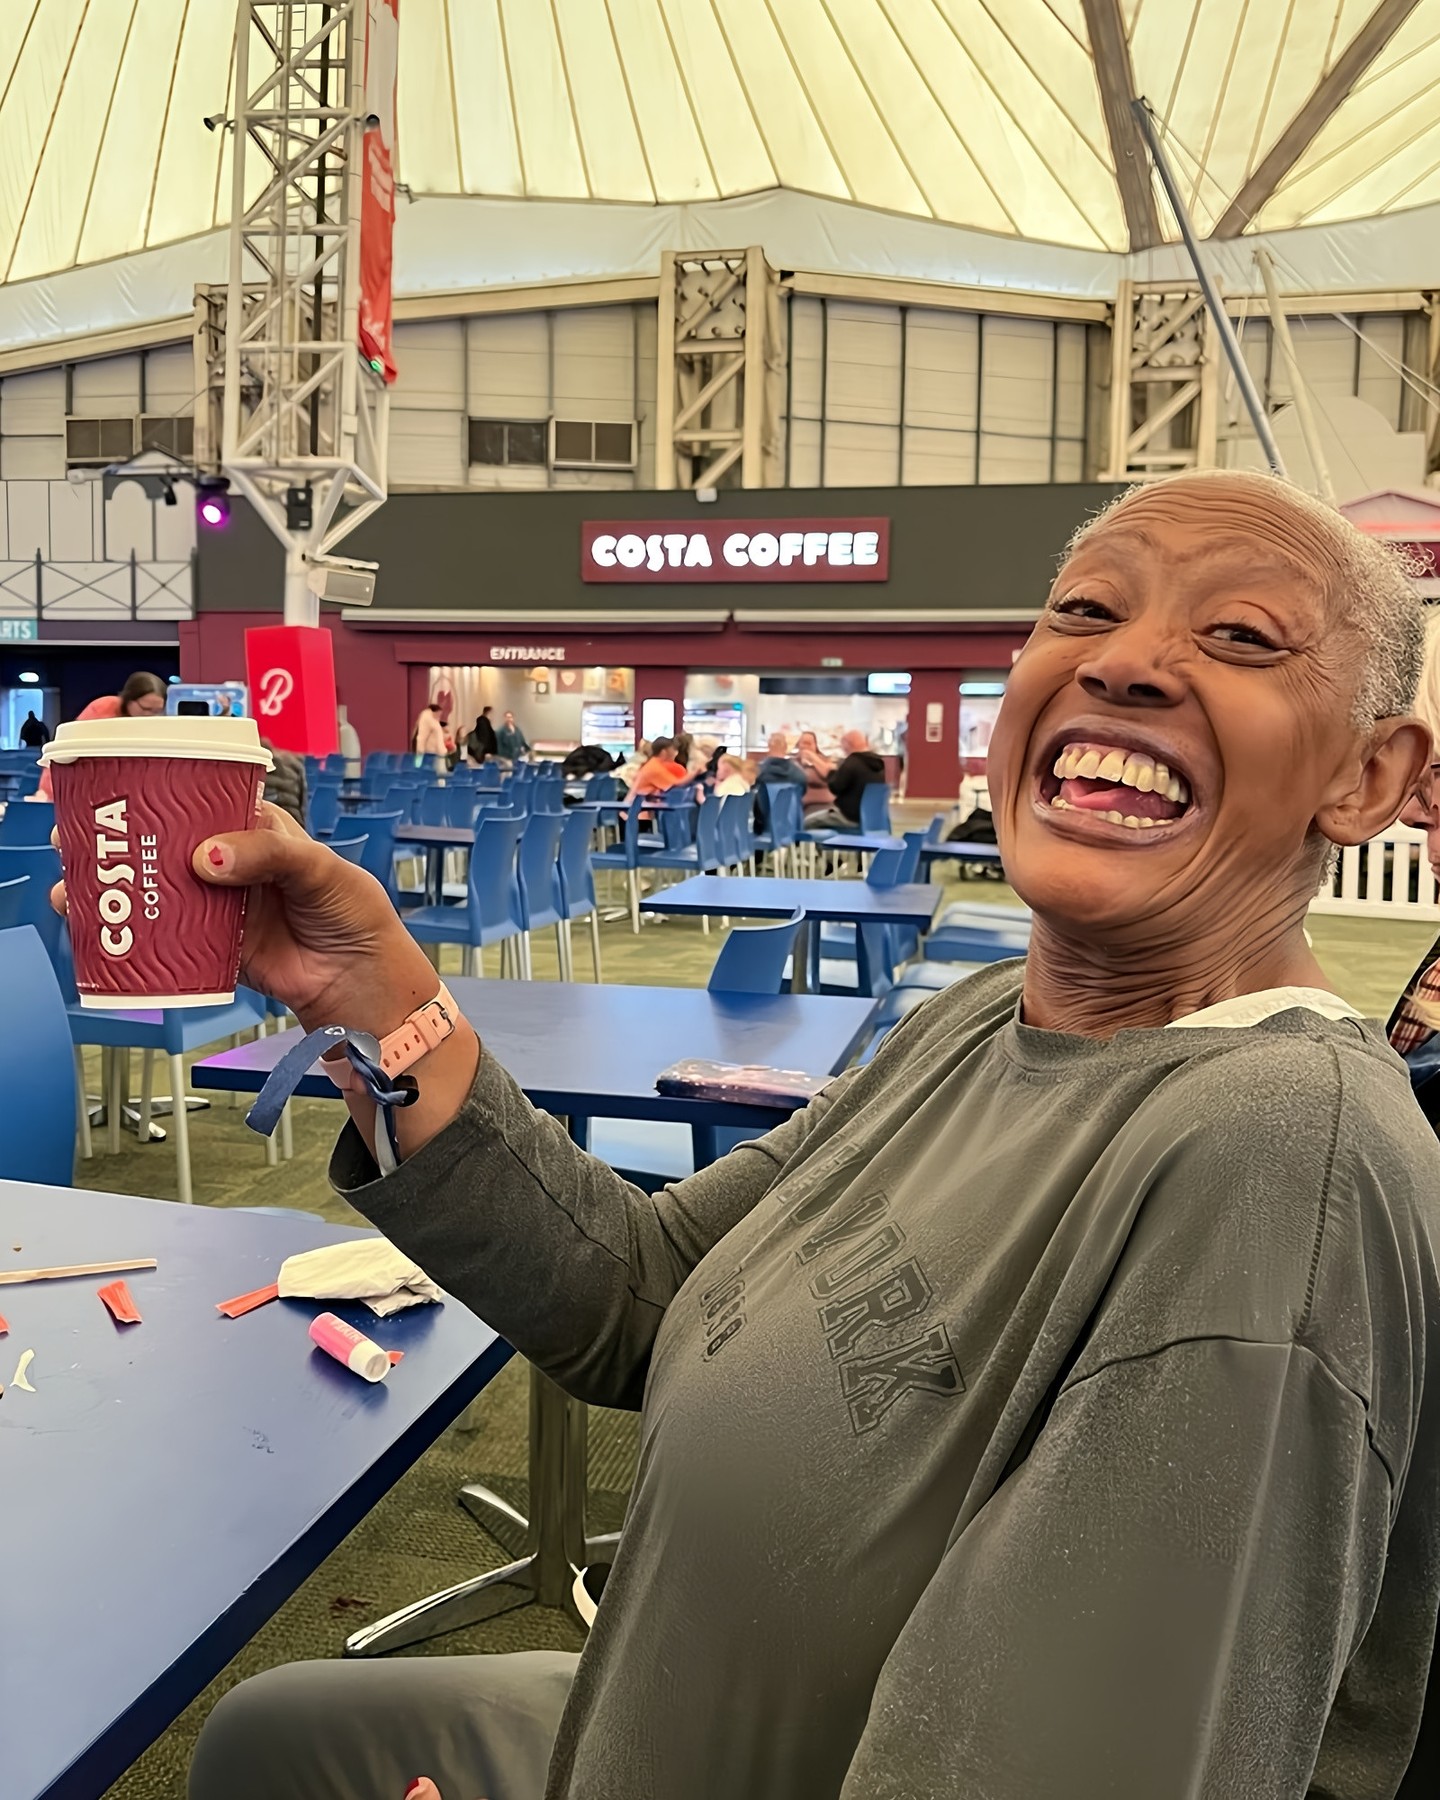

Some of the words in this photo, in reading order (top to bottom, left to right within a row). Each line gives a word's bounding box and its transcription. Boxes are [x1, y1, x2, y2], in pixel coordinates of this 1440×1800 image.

[592, 534, 713, 572] COSTA
[723, 532, 879, 567] COFFEE
[490, 646, 565, 660] ENTRANCE
[260, 667, 294, 716] B
[95, 799, 135, 956] COSTA
[141, 834, 160, 920] COFFEE
[794, 1189, 967, 1436] YORK
